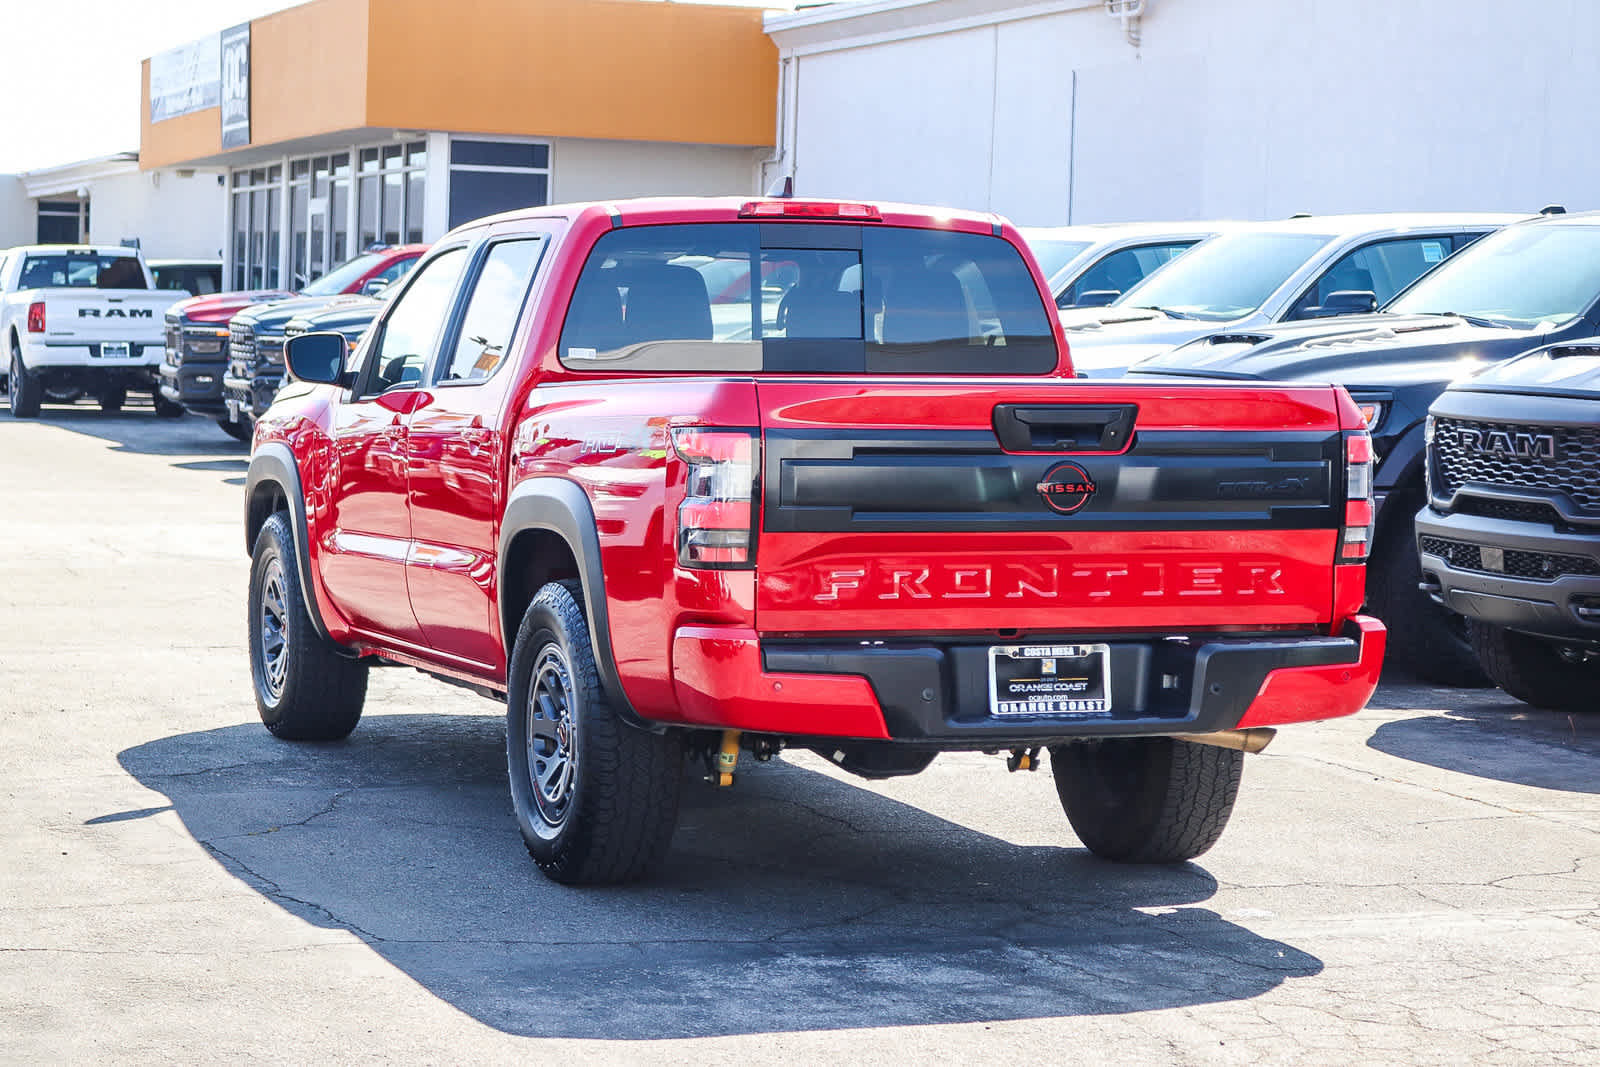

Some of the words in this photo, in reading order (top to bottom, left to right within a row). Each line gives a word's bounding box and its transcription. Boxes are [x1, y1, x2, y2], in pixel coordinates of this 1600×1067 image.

[78, 308, 153, 318] RAM
[1456, 428, 1554, 459] RAM
[1038, 483, 1095, 493] NISSAN
[813, 563, 1285, 601] FRONTIER
[1009, 684, 1053, 692] ORANGE
[1054, 682, 1088, 691] COAST
[1000, 702, 1054, 712] ORANGE
[1059, 701, 1103, 711] COAST
